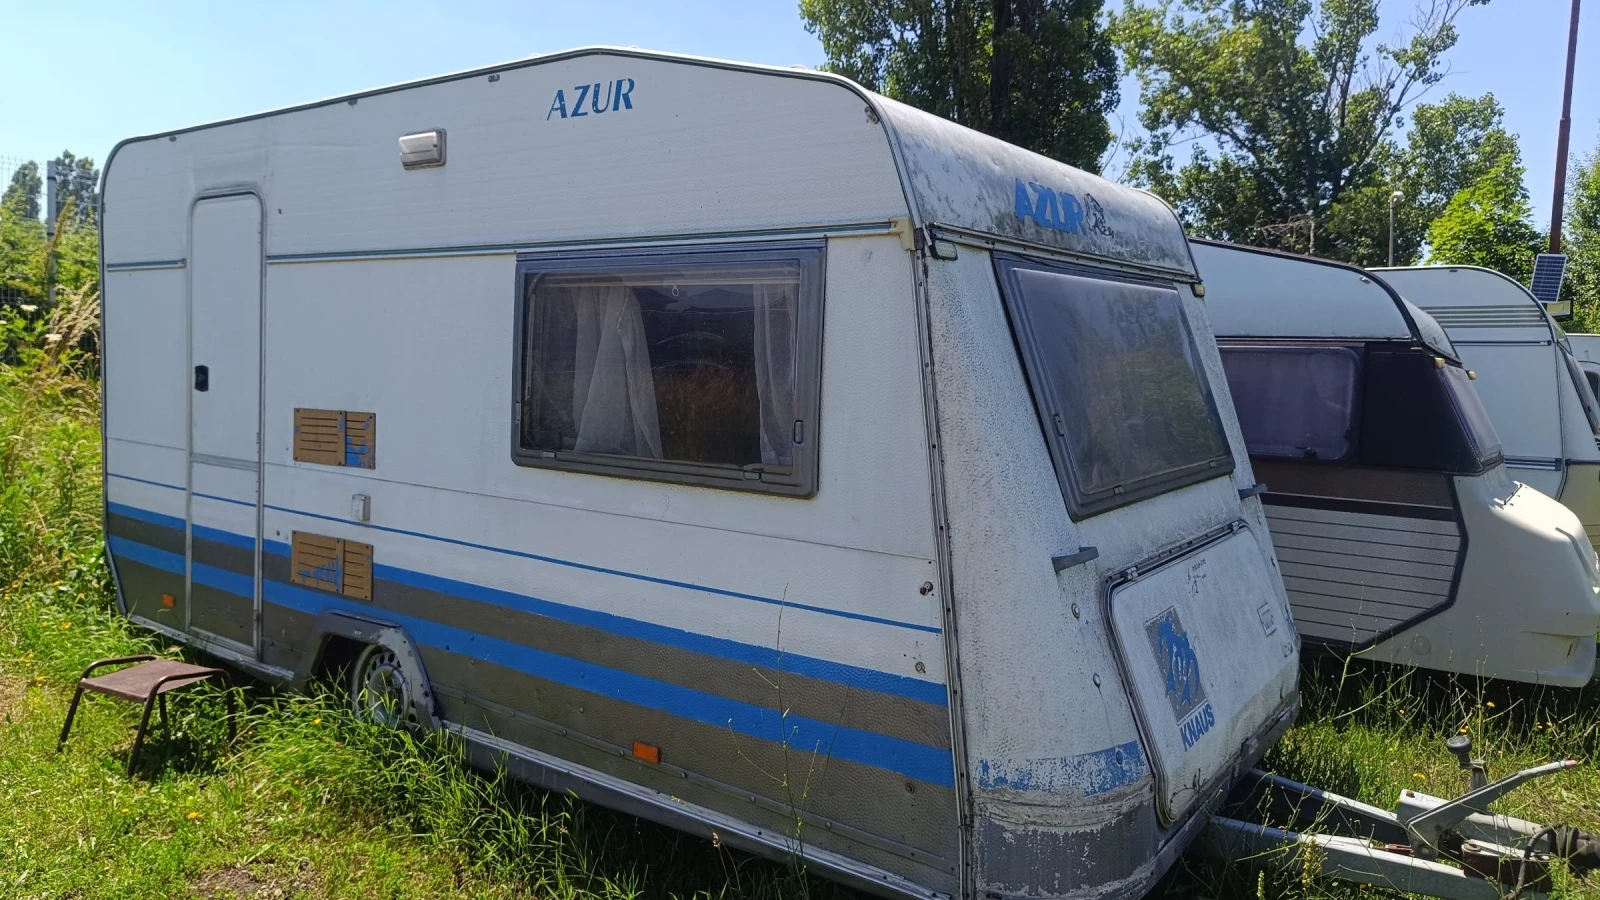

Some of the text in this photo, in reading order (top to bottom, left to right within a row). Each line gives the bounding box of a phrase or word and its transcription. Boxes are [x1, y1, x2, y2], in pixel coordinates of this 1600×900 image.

[547, 78, 635, 121] AZUR
[1015, 178, 1086, 236] AZUR
[1179, 703, 1215, 751] KNAUS
